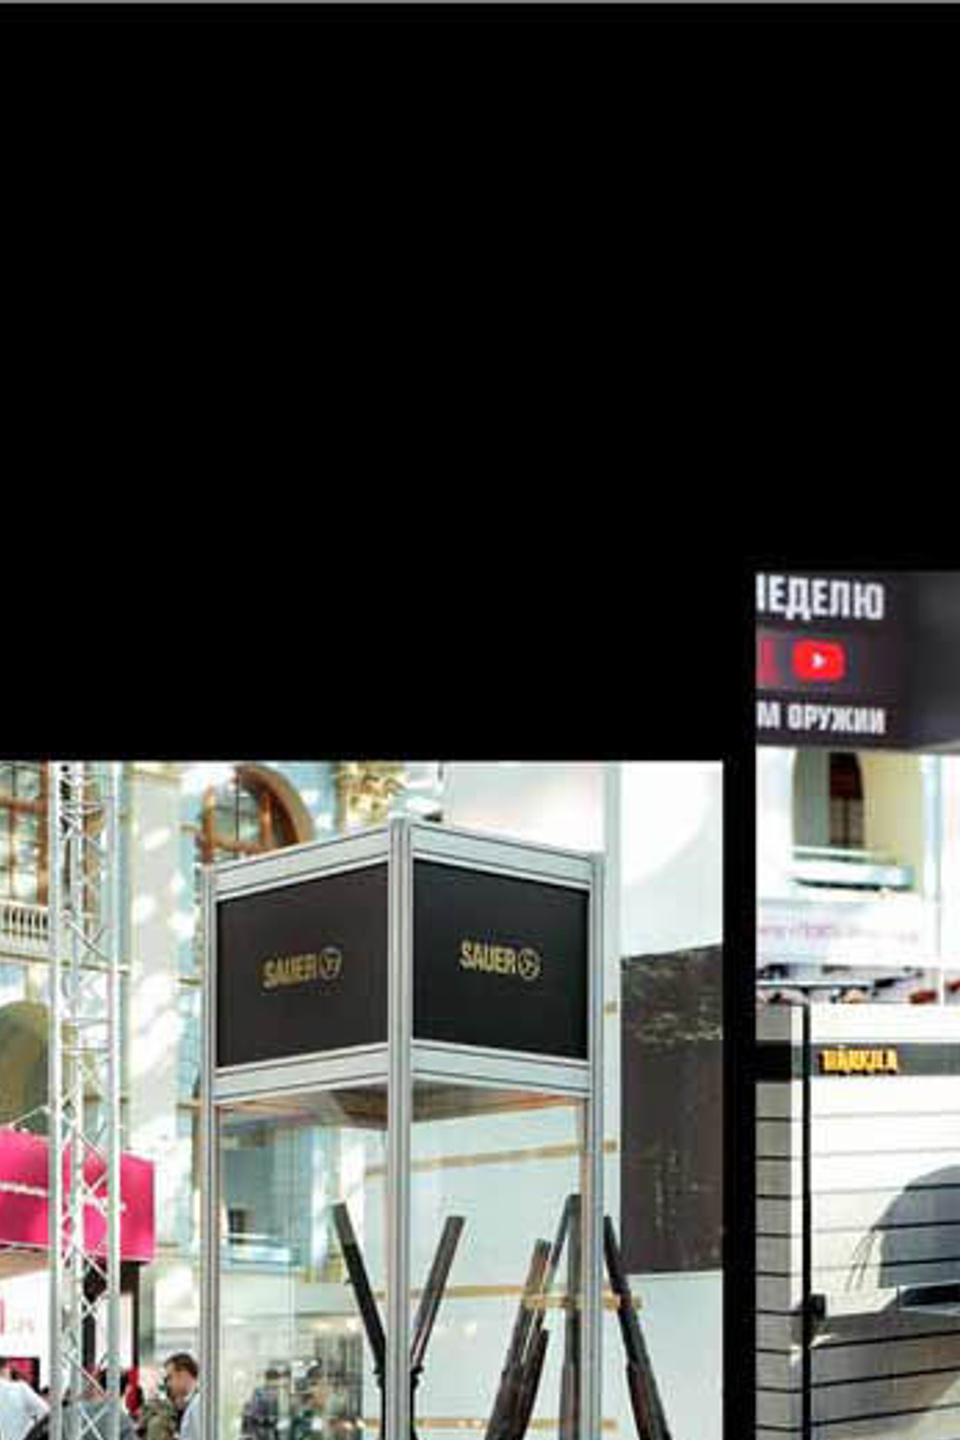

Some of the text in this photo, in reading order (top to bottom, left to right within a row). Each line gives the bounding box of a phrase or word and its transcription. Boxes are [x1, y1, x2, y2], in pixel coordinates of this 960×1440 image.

[787, 704, 886, 734] ОРУЖИИ
[262, 951, 317, 988] SAUER
[460, 939, 517, 974] SAUER
